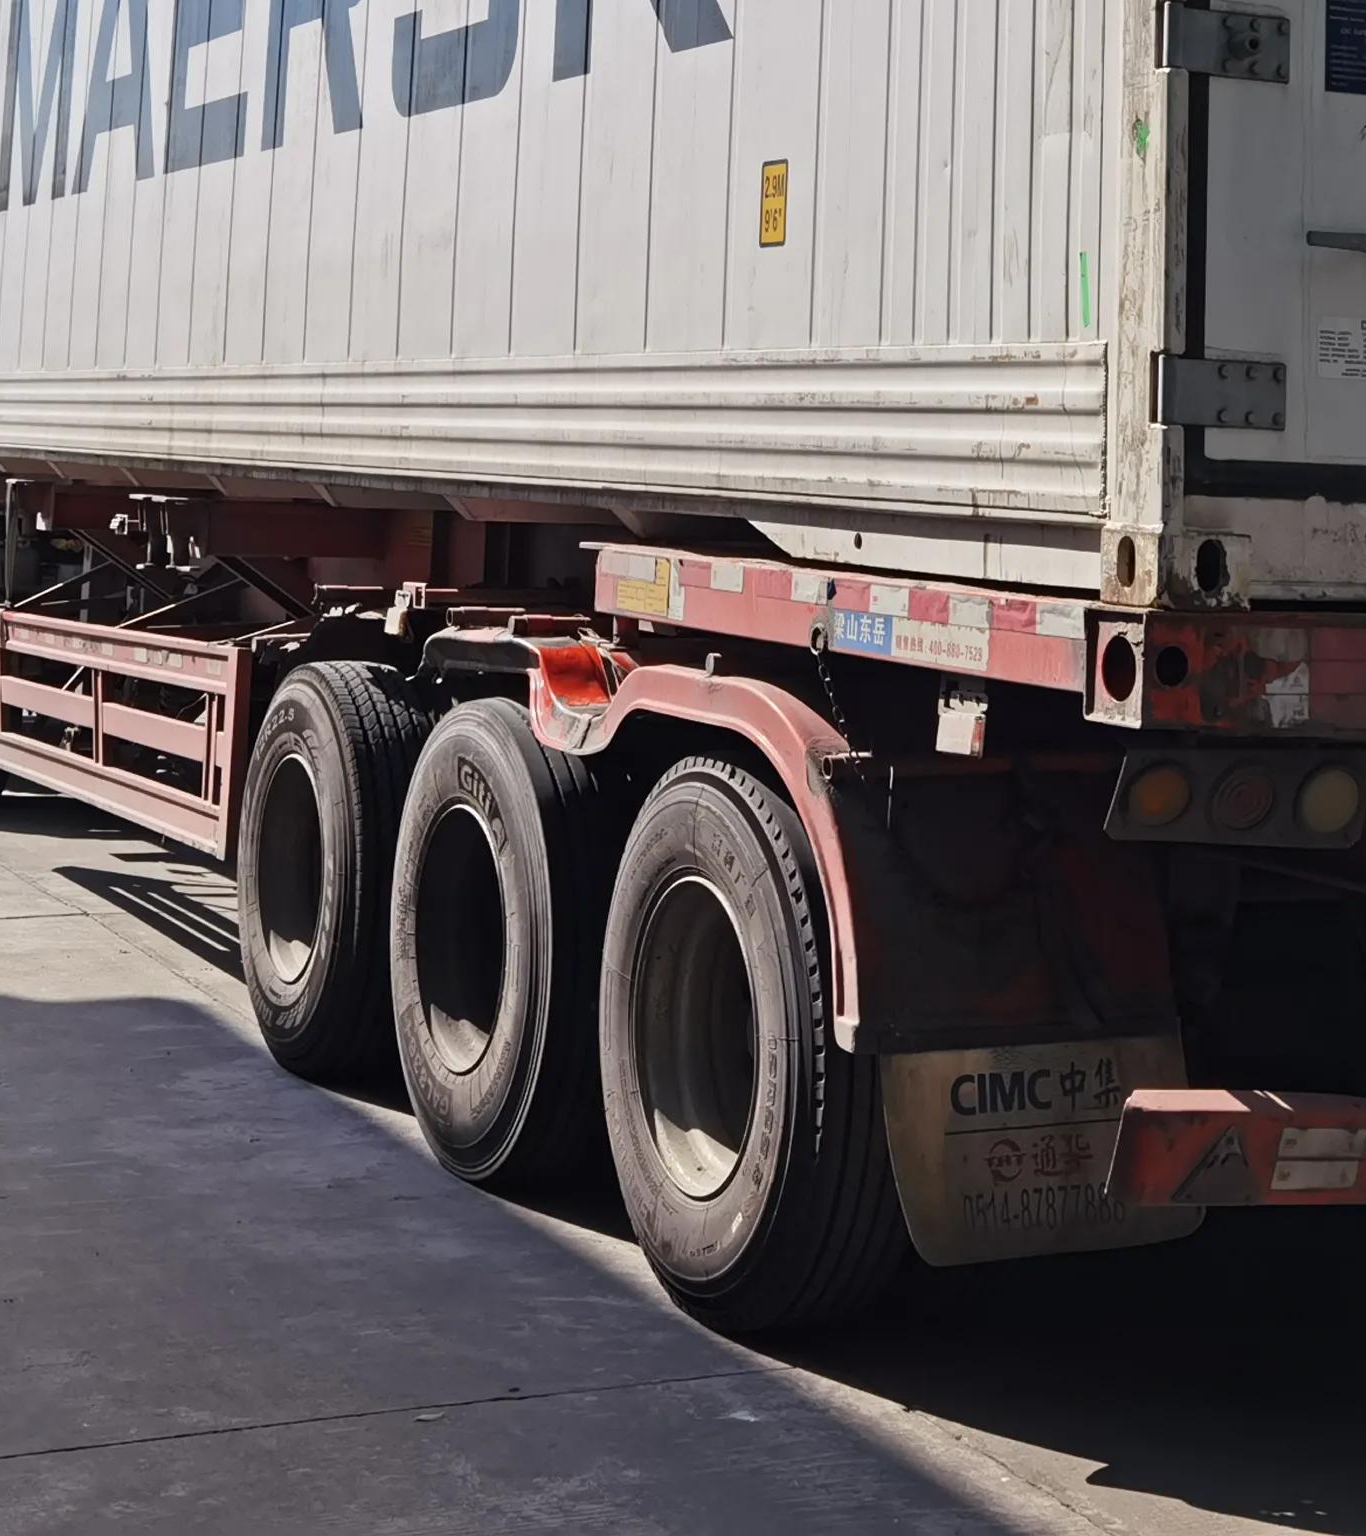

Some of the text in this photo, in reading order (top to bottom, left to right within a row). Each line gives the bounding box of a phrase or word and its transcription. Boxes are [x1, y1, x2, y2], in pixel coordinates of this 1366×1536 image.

[460, 764, 492, 816] Giti
[950, 1058, 1120, 1116] CIMC 中集
